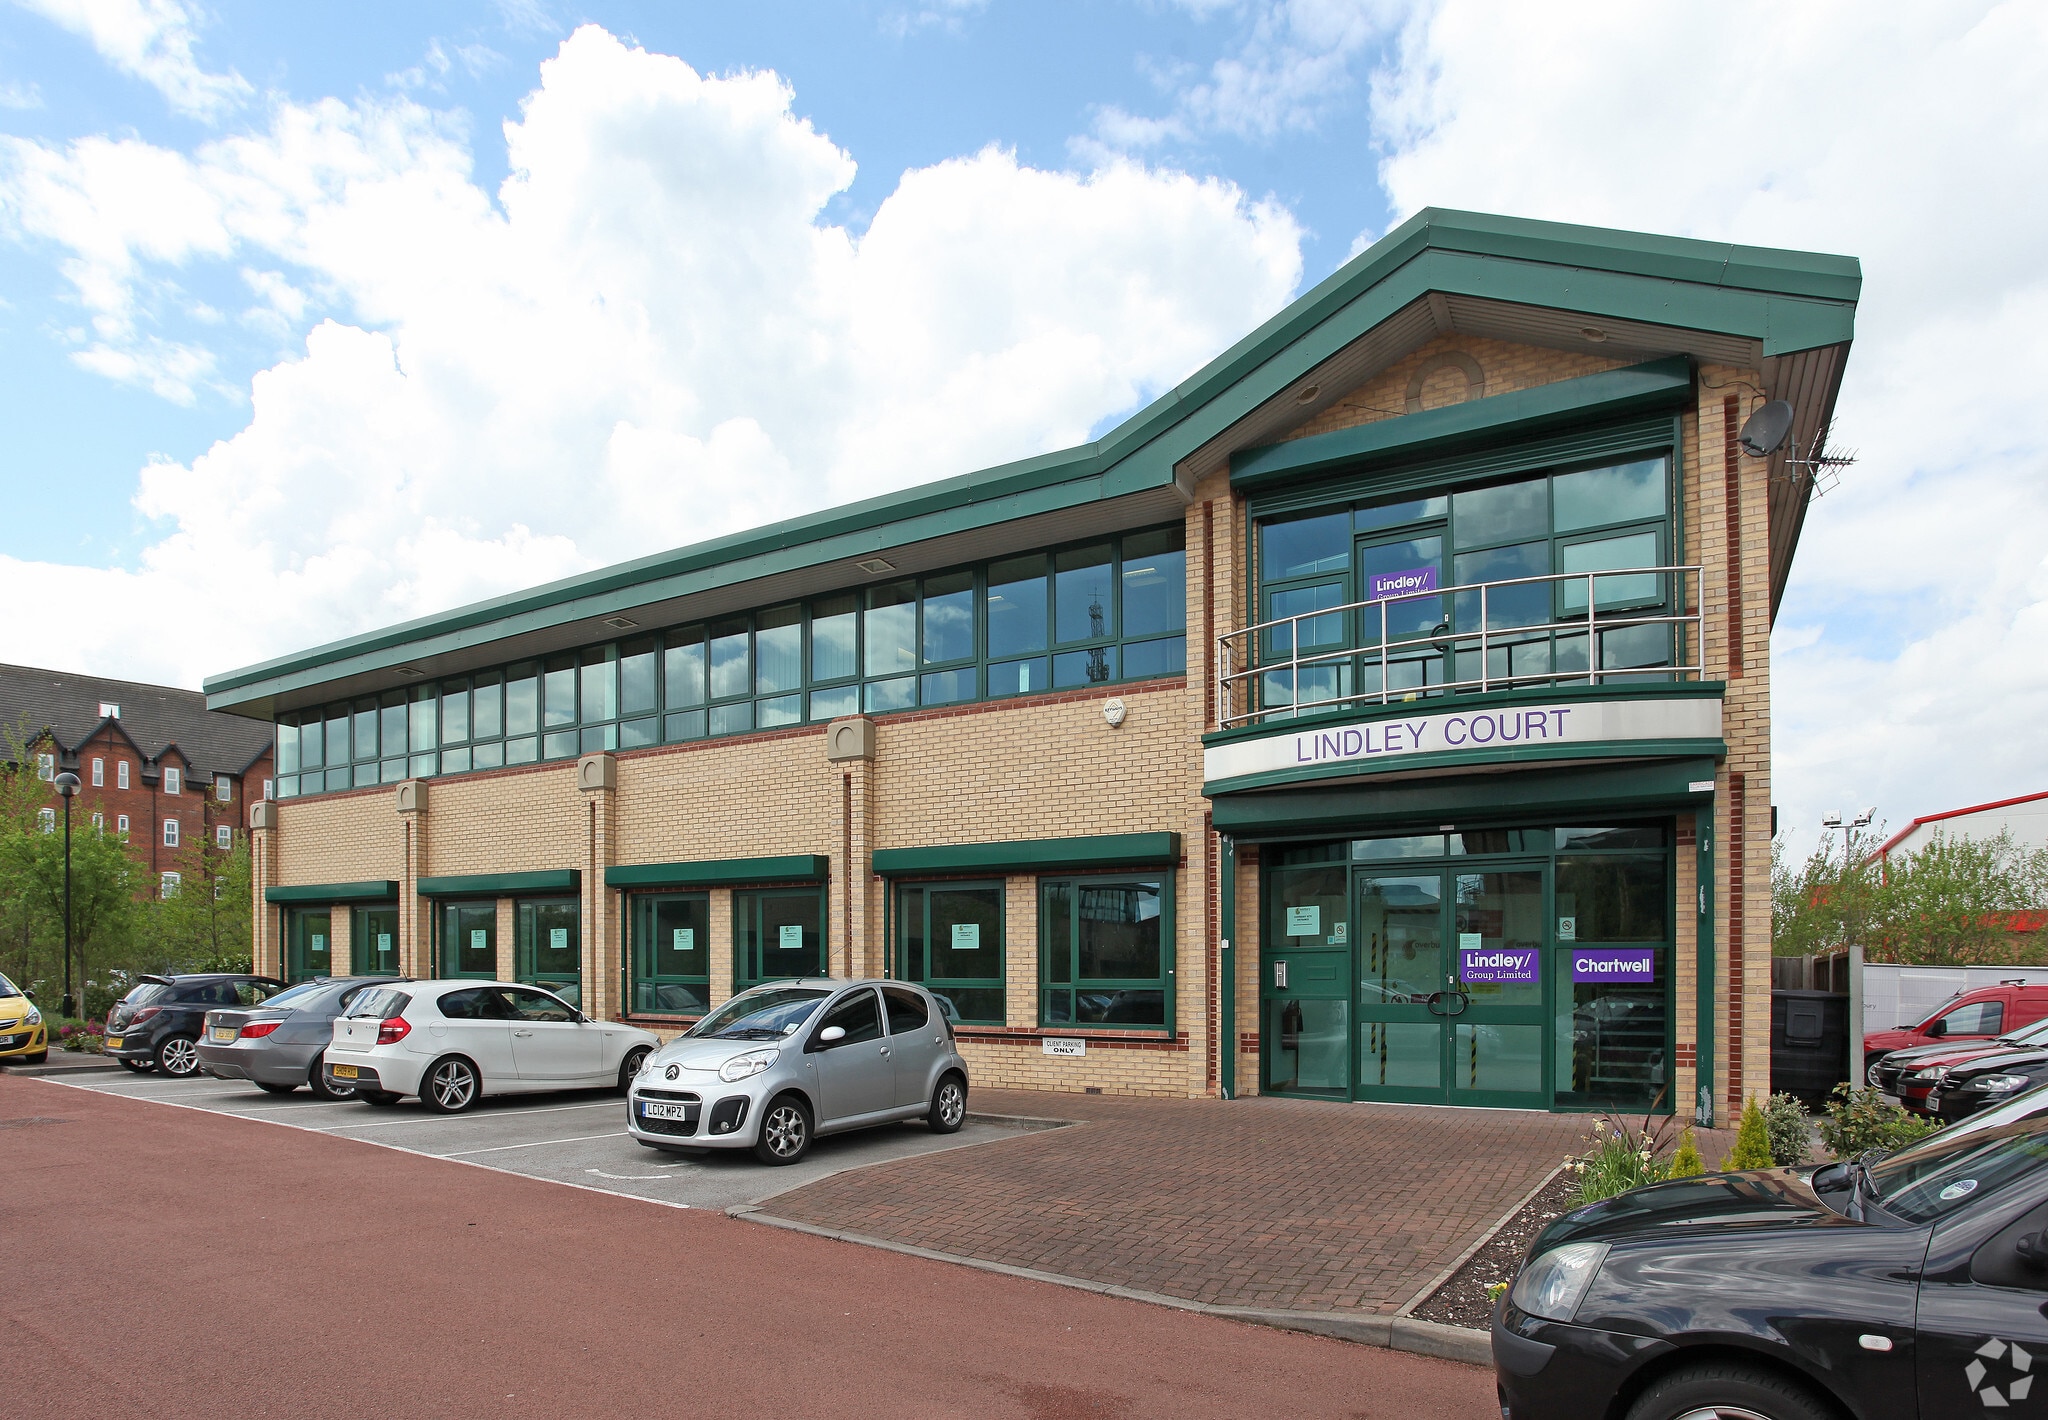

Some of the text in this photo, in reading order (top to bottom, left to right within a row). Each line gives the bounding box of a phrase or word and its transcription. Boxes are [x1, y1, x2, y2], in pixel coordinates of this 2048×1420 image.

[1376, 572, 1429, 592] Lindley/
[1297, 709, 1571, 762] LINDLEY COURT
[1466, 952, 1532, 970] Lindley/
[1575, 958, 1650, 973] Chartwell
[1466, 970, 1532, 980] Group Limited
[648, 1104, 682, 1118] LC12 MPZ
